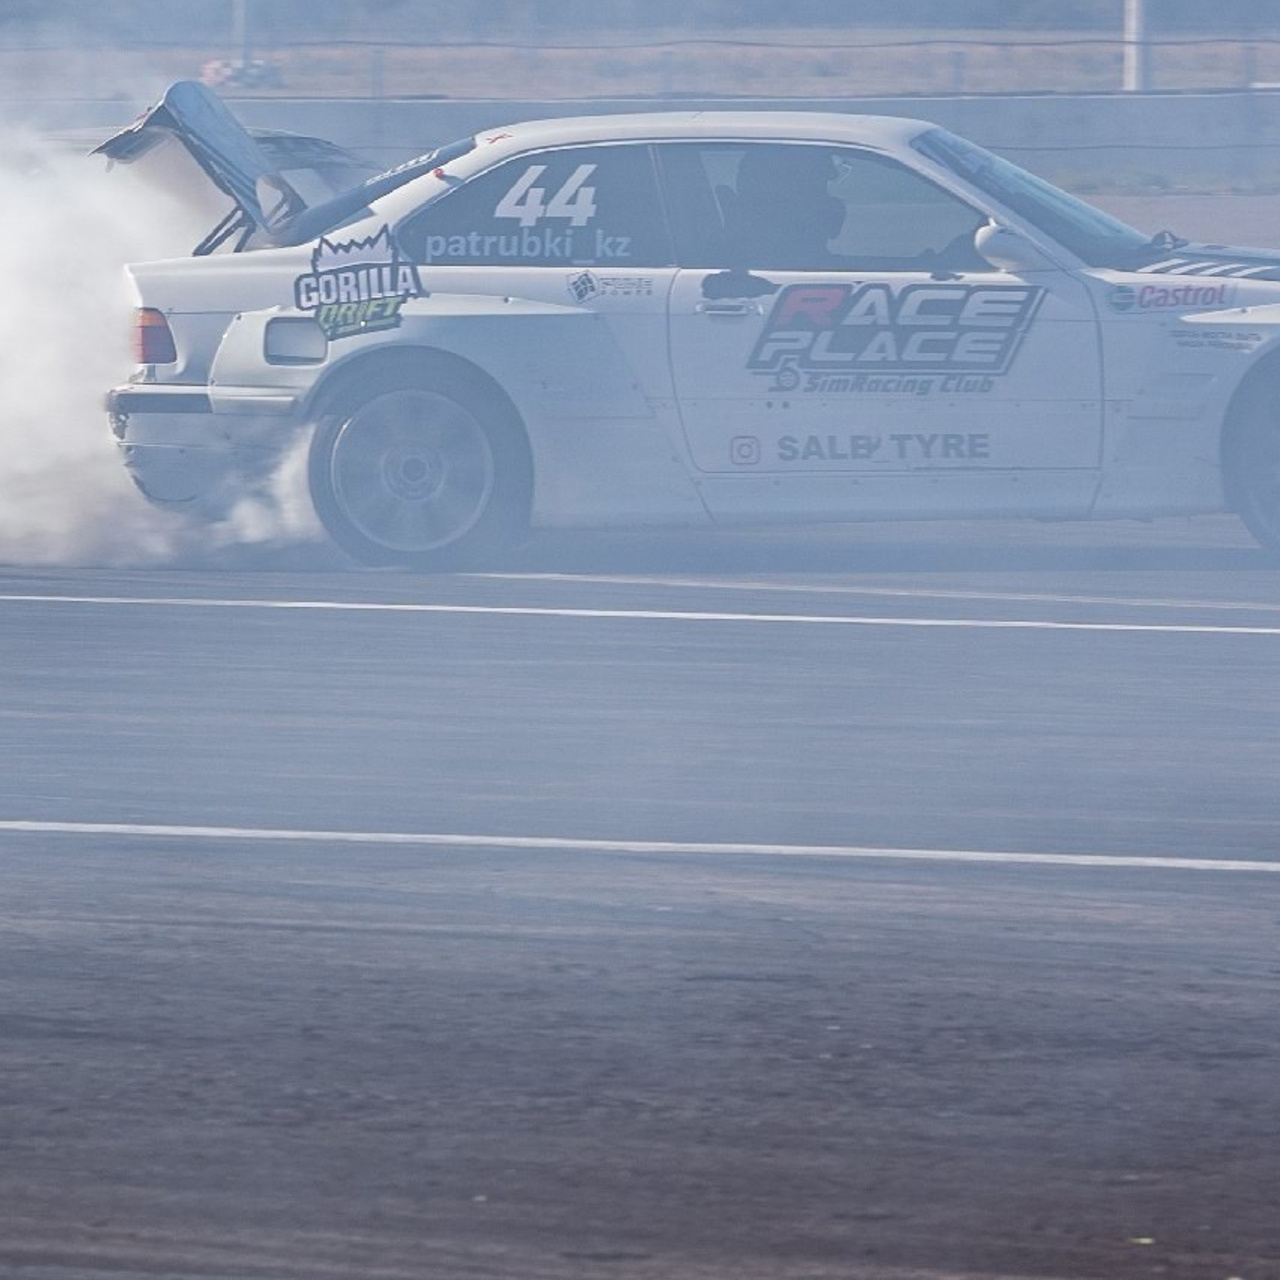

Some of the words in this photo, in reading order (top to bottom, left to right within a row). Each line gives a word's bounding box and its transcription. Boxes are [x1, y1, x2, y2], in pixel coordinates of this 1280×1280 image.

[493, 163, 598, 227] 44
[298, 265, 418, 308] GORILLA
[1138, 284, 1227, 308] Castrol
[318, 297, 402, 326] DRIFT
[772, 288, 1031, 326] RACE
[758, 330, 1010, 362] PLACE
[802, 376, 935, 396] SimRacing
[940, 376, 995, 393] Club
